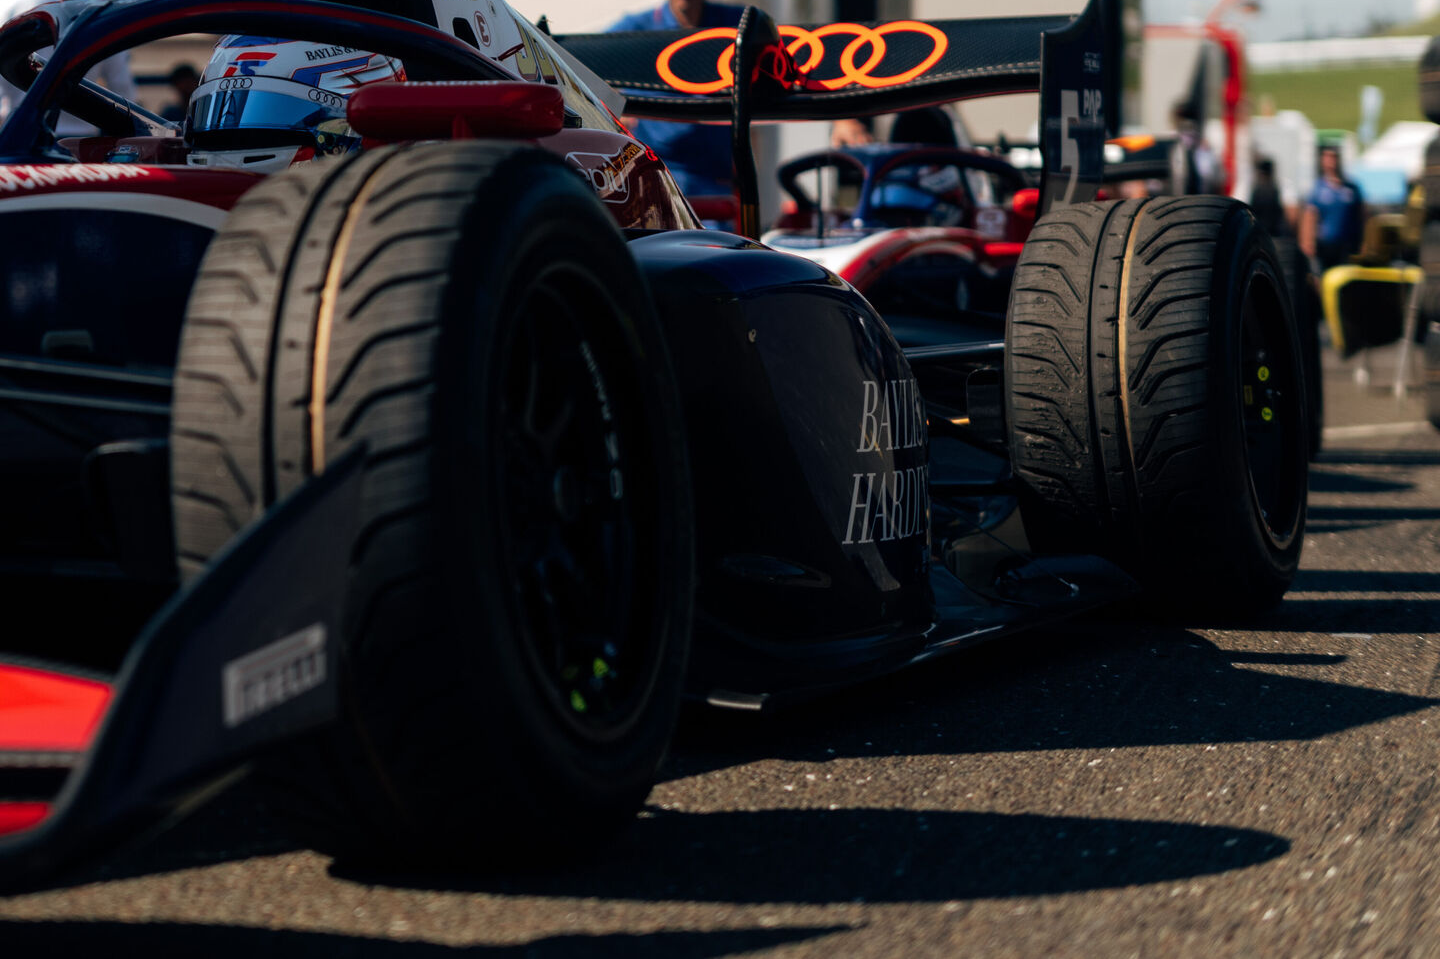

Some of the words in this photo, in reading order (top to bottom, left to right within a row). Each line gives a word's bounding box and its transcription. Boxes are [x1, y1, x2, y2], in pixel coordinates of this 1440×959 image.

[305, 46, 343, 61] BAYLIS
[857, 380, 926, 453] BAYLIS
[223, 622, 327, 728] PIRELLI
